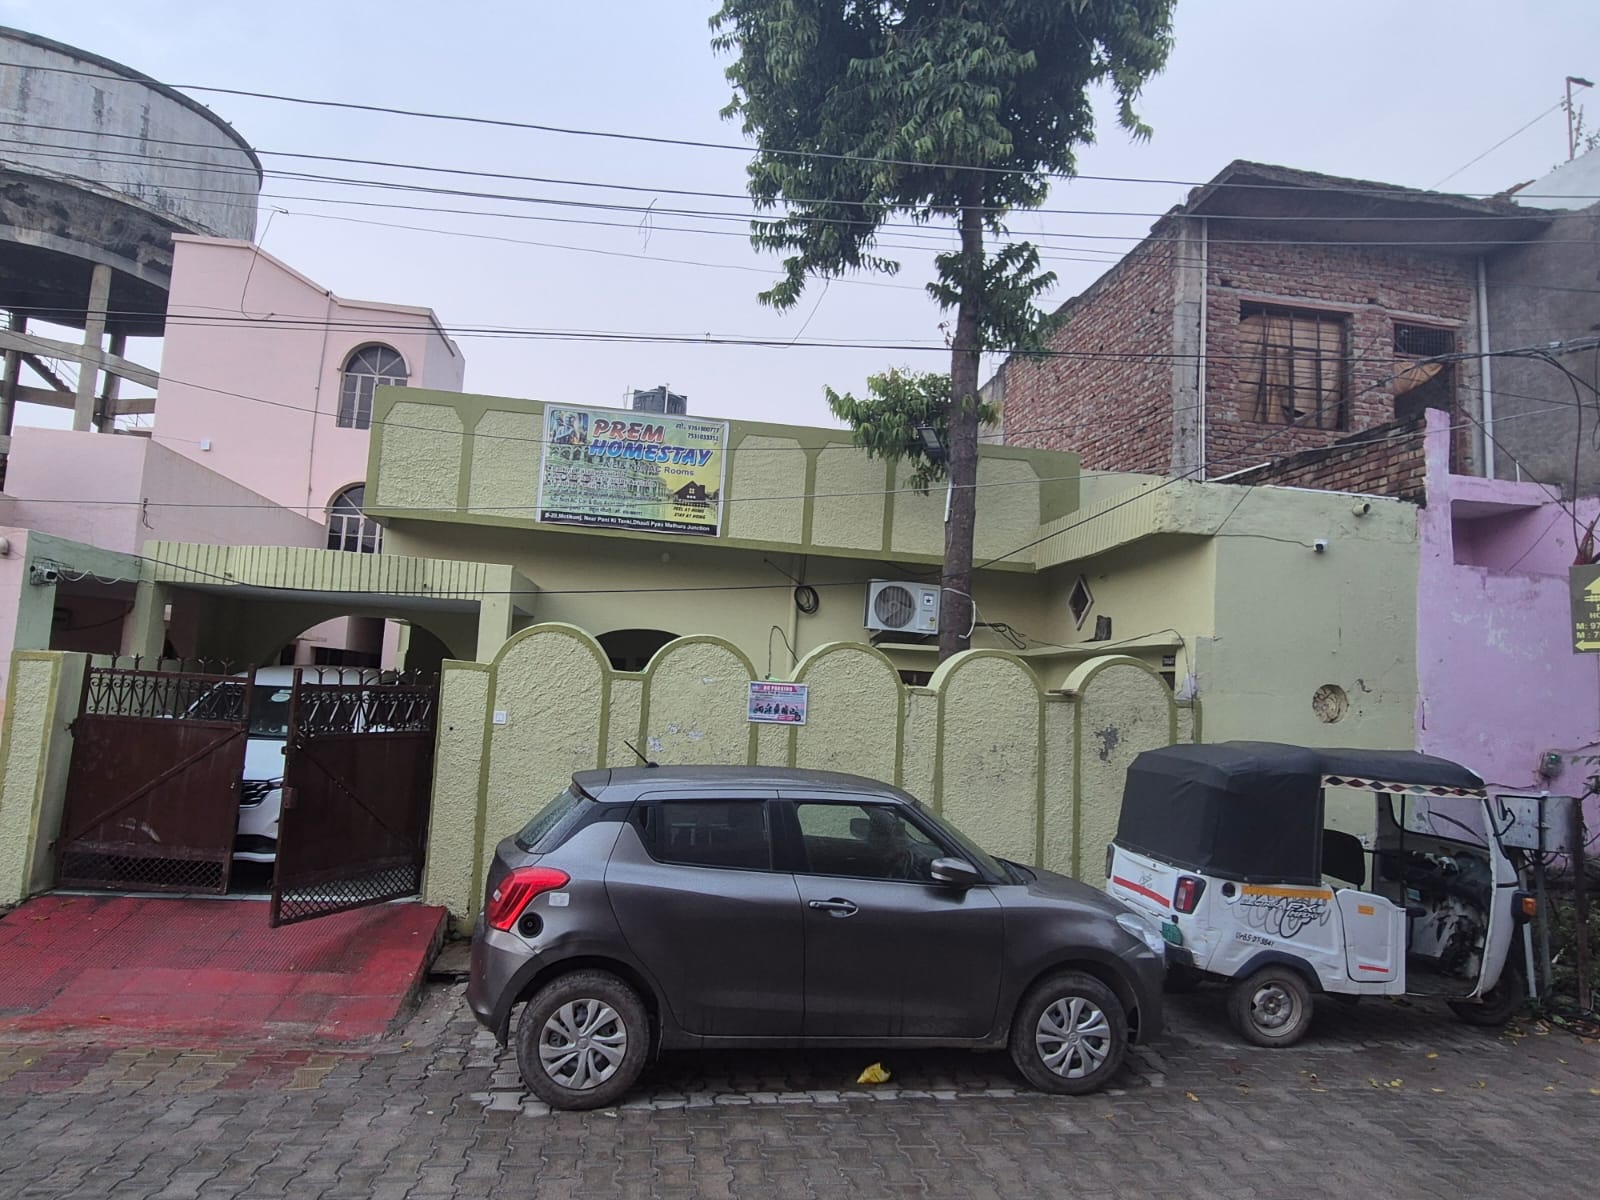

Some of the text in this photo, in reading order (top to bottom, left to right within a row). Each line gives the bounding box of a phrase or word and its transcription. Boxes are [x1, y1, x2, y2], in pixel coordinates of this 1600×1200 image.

[593, 419, 665, 442] PREM
[589, 440, 713, 466] HOMESTAY
[664, 466, 694, 476] Rooms
